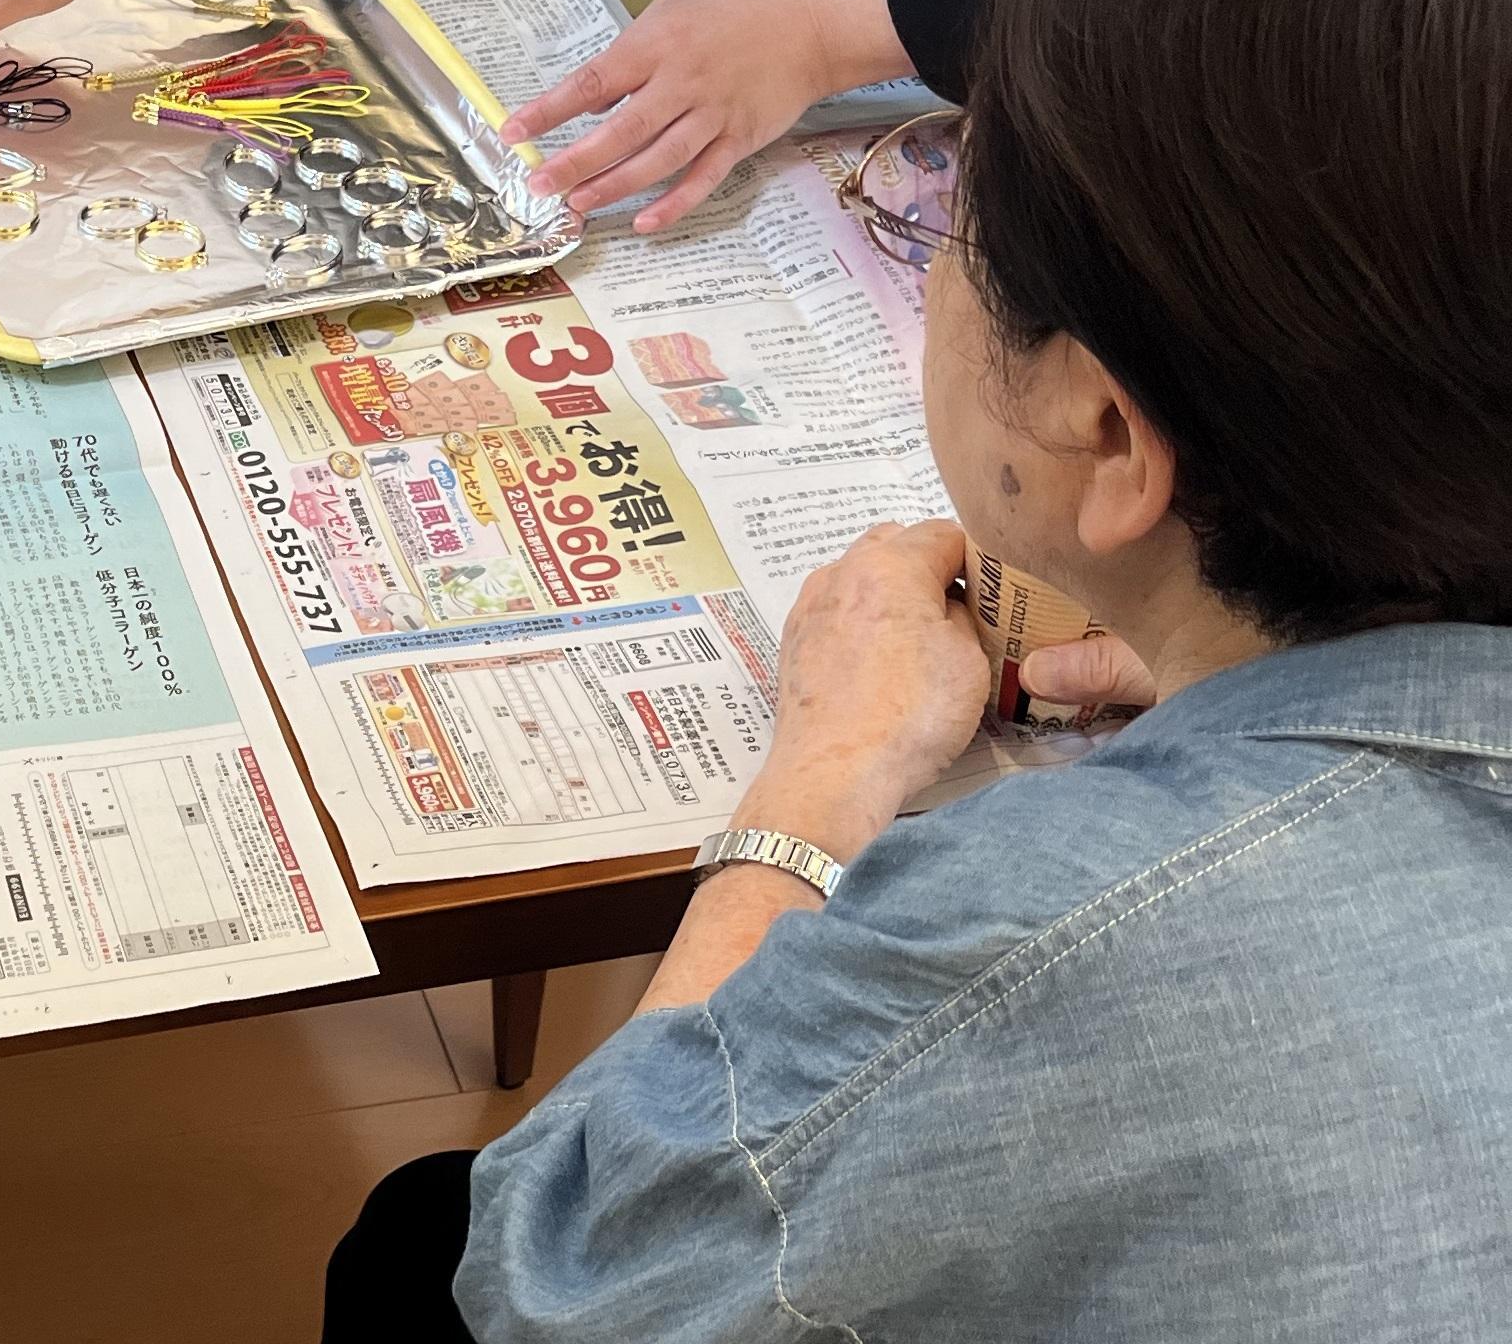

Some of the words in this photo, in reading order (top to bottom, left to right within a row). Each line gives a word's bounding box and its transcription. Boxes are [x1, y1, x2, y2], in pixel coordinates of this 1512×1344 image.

[497, 312, 543, 329] 合計
[481, 433, 516, 485] 42%OFF
[236, 449, 343, 636] 0120-555-737
[405, 478, 465, 555] 扇風機
[95, 568, 144, 672] 低分子コラーゲン
[628, 642, 652, 666] 6608
[716, 683, 761, 753] 700-8796
